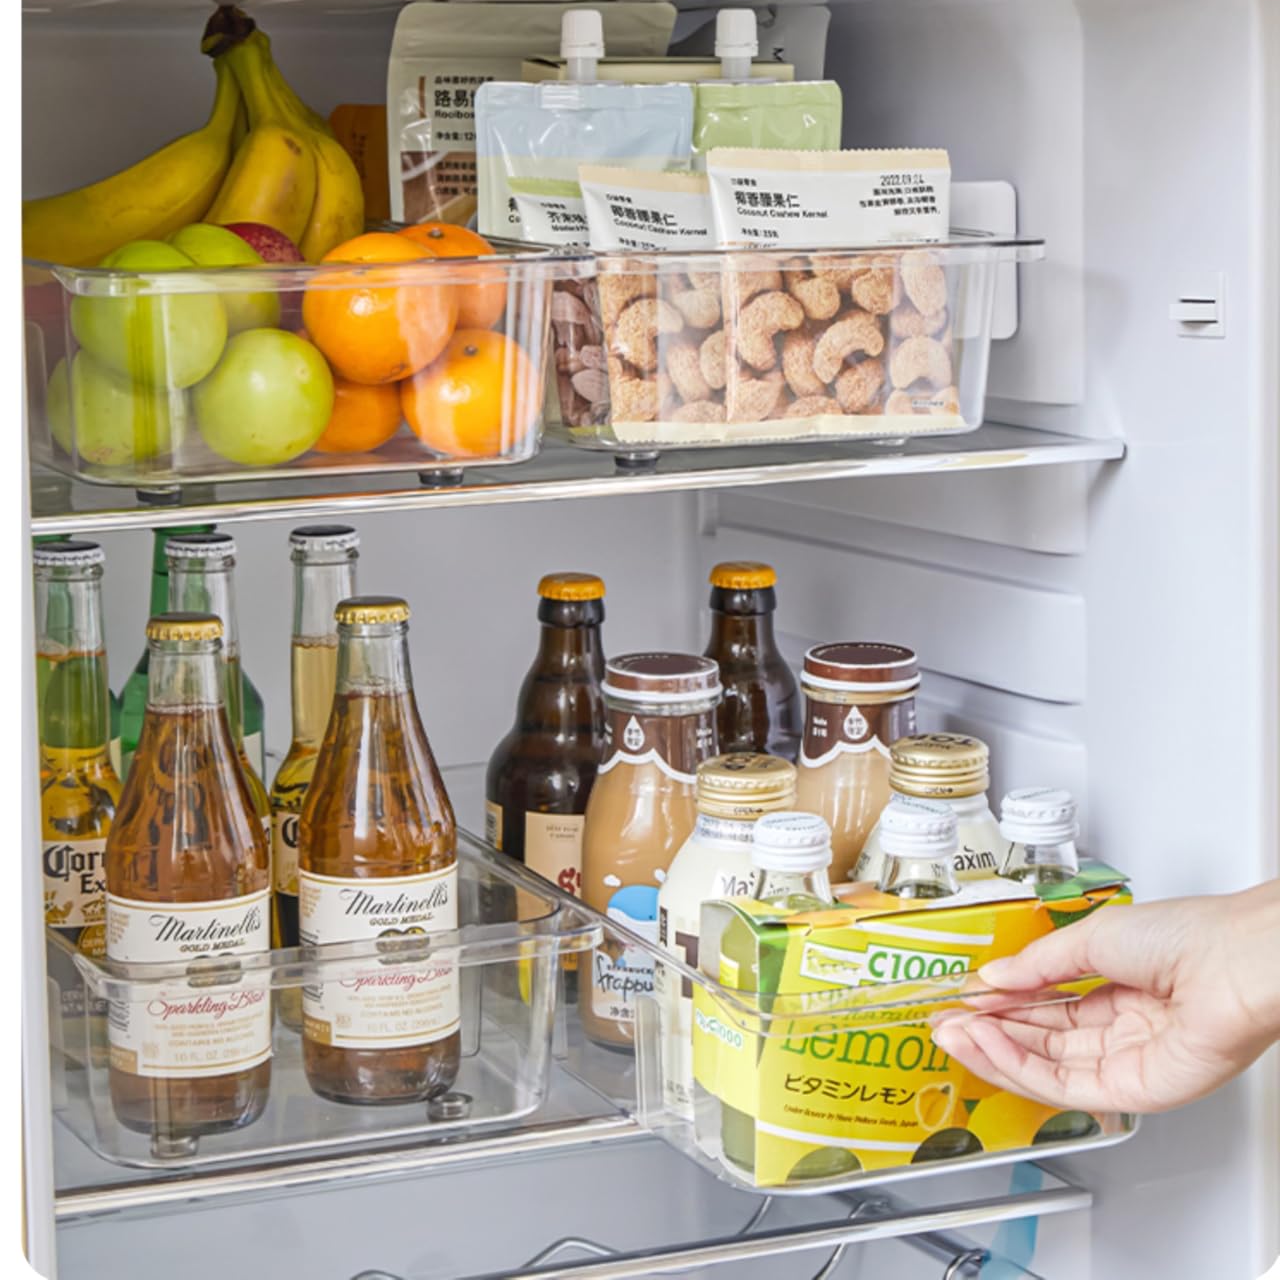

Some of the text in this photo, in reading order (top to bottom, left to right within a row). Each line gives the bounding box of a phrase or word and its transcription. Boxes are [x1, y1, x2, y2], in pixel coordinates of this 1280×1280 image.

[434, 90, 475, 108] 路易
[802, 210, 829, 219] Kernel
[953, 846, 997, 870] axim
[369, 915, 399, 926] GOLD
[179, 939, 246, 953] GOLD MEDAL
[868, 951, 966, 981] C1000
[784, 1073, 917, 1105] ビタミンレモン
